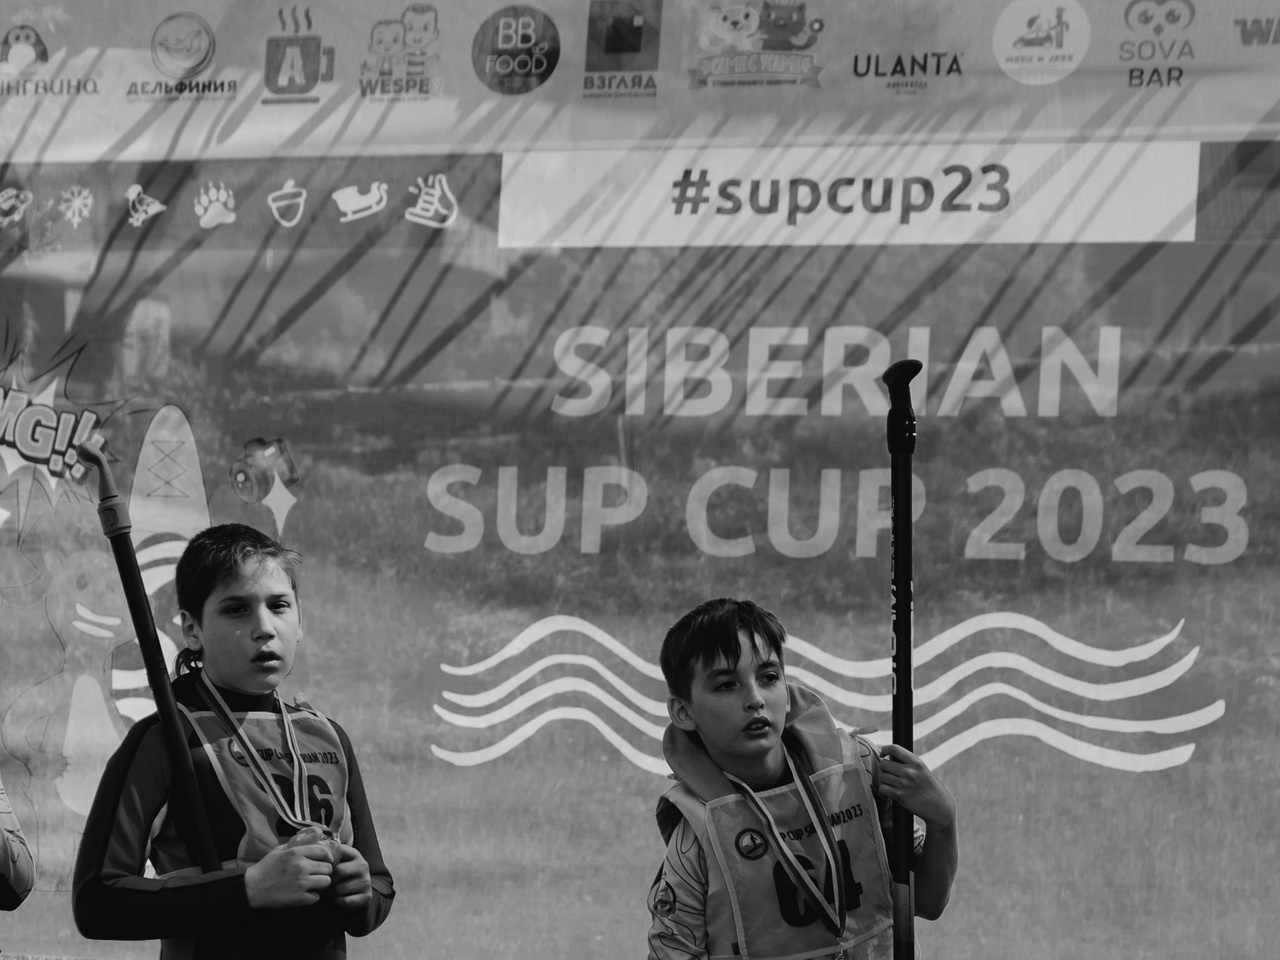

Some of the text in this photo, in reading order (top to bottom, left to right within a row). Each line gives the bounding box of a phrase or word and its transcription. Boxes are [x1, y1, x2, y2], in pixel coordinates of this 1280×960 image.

[499, 17, 536, 49] BB
[1119, 39, 1195, 62] SOVA
[486, 53, 548, 75] FOOD
[853, 52, 963, 77] ULANTA
[126, 79, 238, 96] ДЕЛЬФИНИЯ
[358, 77, 430, 97] WESPE
[584, 75, 657, 90] ВЗГЛЯД
[1128, 66, 1184, 88] BAR
[671, 163, 1011, 226] #supcup23
[550, 325, 1122, 419] SIBERIAN
[424, 465, 1250, 565] SUP CUP 2023
[842, 803, 864, 825] 2023
